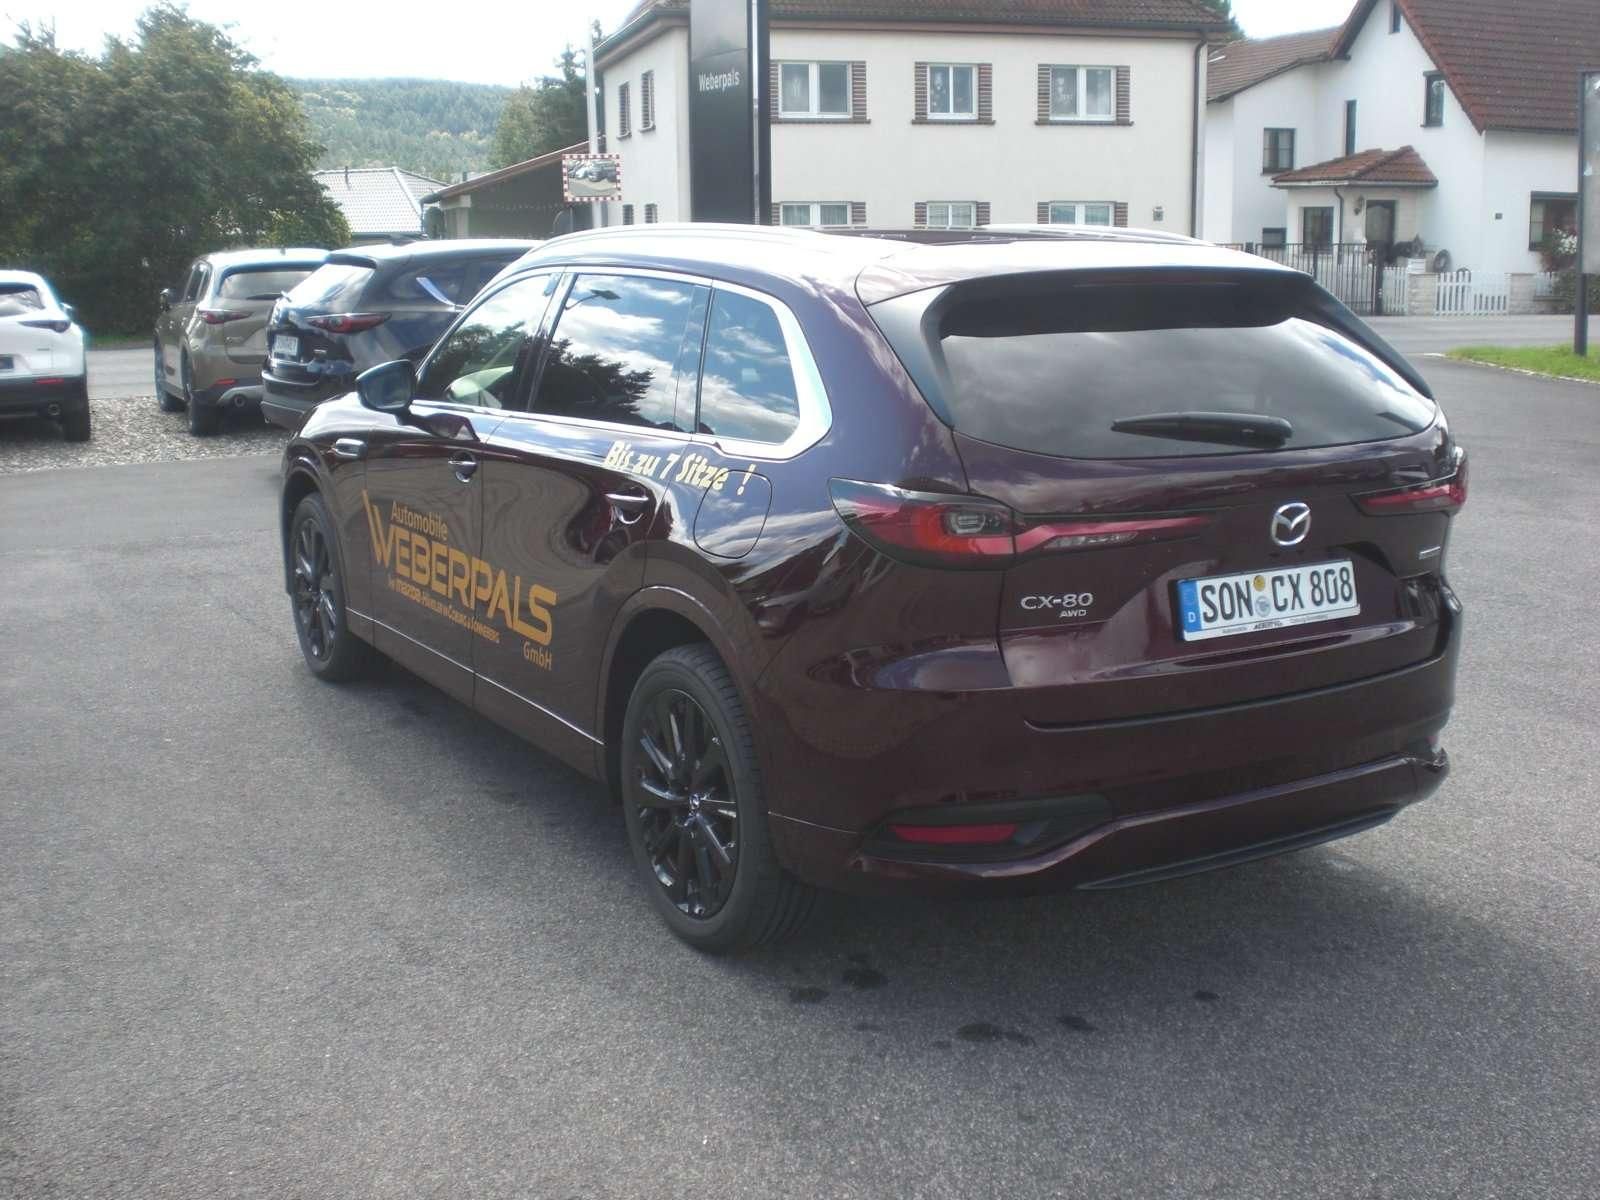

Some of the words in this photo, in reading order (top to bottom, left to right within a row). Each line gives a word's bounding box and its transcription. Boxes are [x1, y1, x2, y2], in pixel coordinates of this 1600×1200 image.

[698, 67, 741, 92] Weberpals
[604, 440, 633, 468] Bis
[632, 453, 661, 477] zu
[659, 453, 681, 480] 7
[675, 452, 729, 491] Sitze
[391, 501, 448, 541] Automobile
[362, 489, 557, 646] WEBERPALS
[1020, 592, 1094, 610] CX-80
[1201, 580, 1254, 623] SON
[1271, 573, 1305, 612] CX
[1311, 566, 1354, 608] 808
[1060, 609, 1087, 618] AWD
[1187, 611, 1196, 623] D
[523, 641, 553, 671] GmbH
